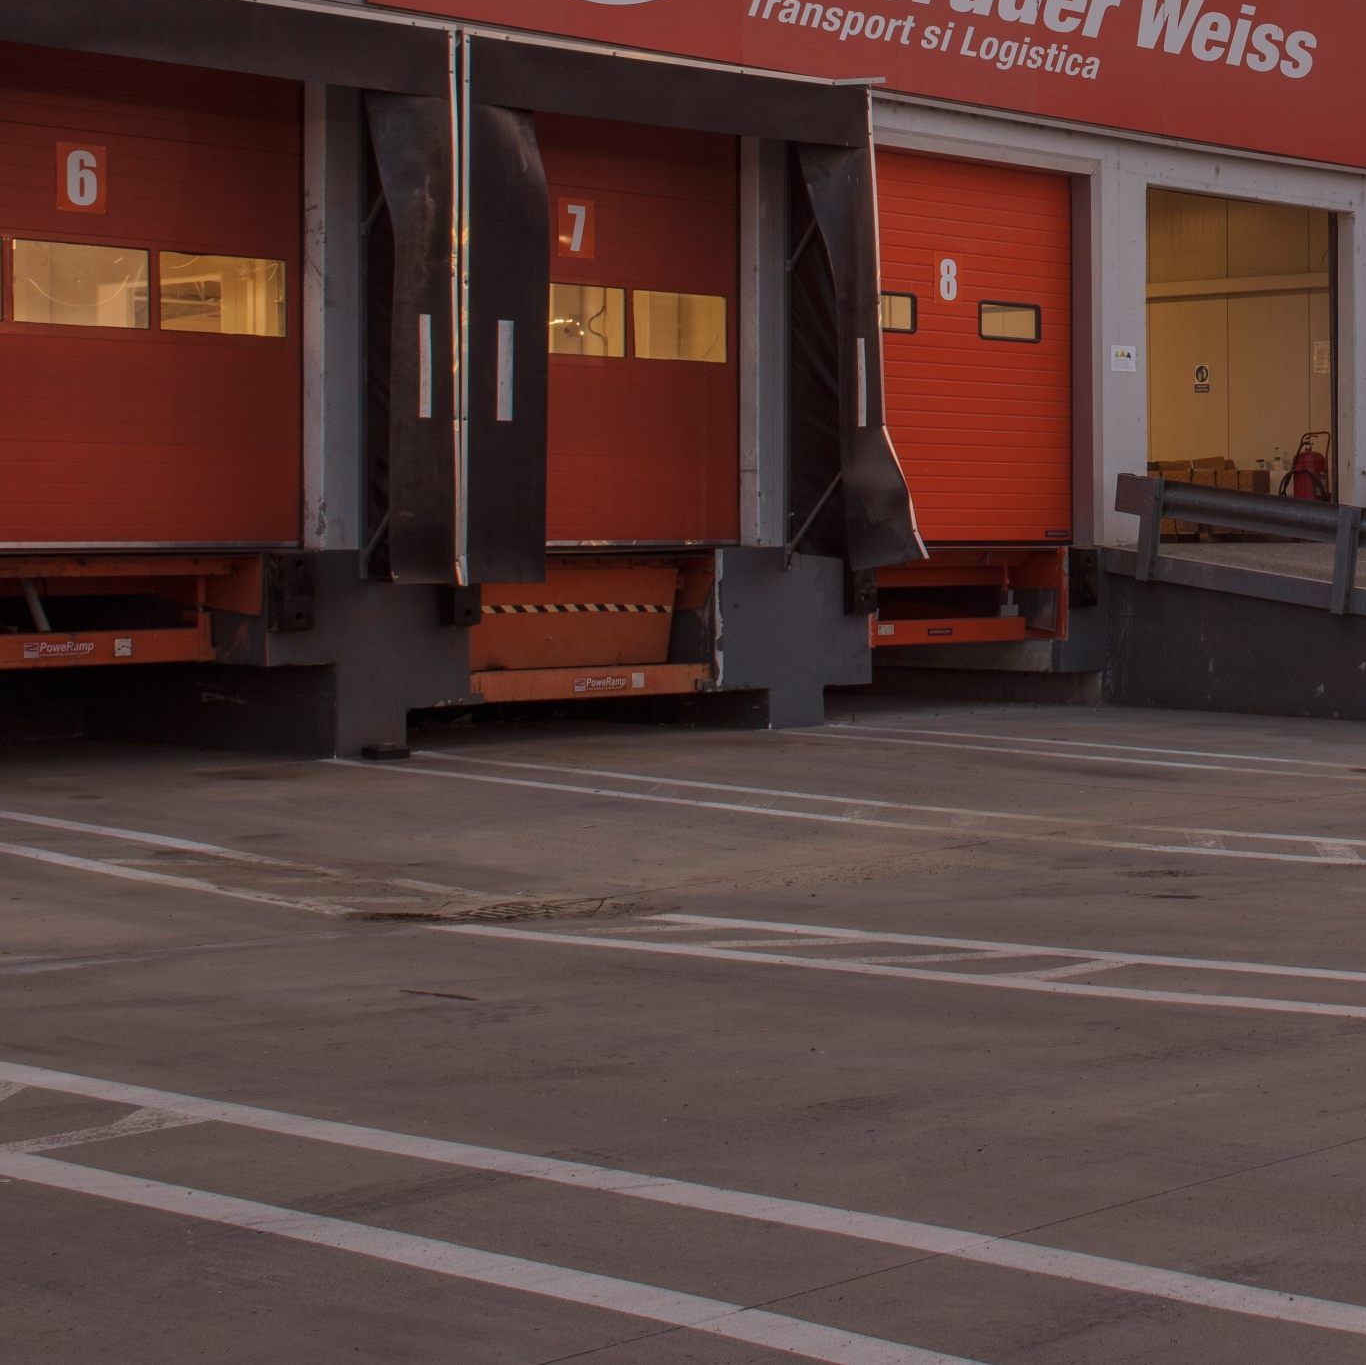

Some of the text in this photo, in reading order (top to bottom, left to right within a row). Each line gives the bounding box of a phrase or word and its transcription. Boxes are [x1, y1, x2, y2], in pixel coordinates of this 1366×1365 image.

[921, 22, 953, 52] si
[960, 26, 1100, 79] Logistica
[67, 150, 97, 205] 6
[567, 204, 586, 252] 7
[939, 258, 958, 301] 8
[40, 642, 94, 653] PoweRamp
